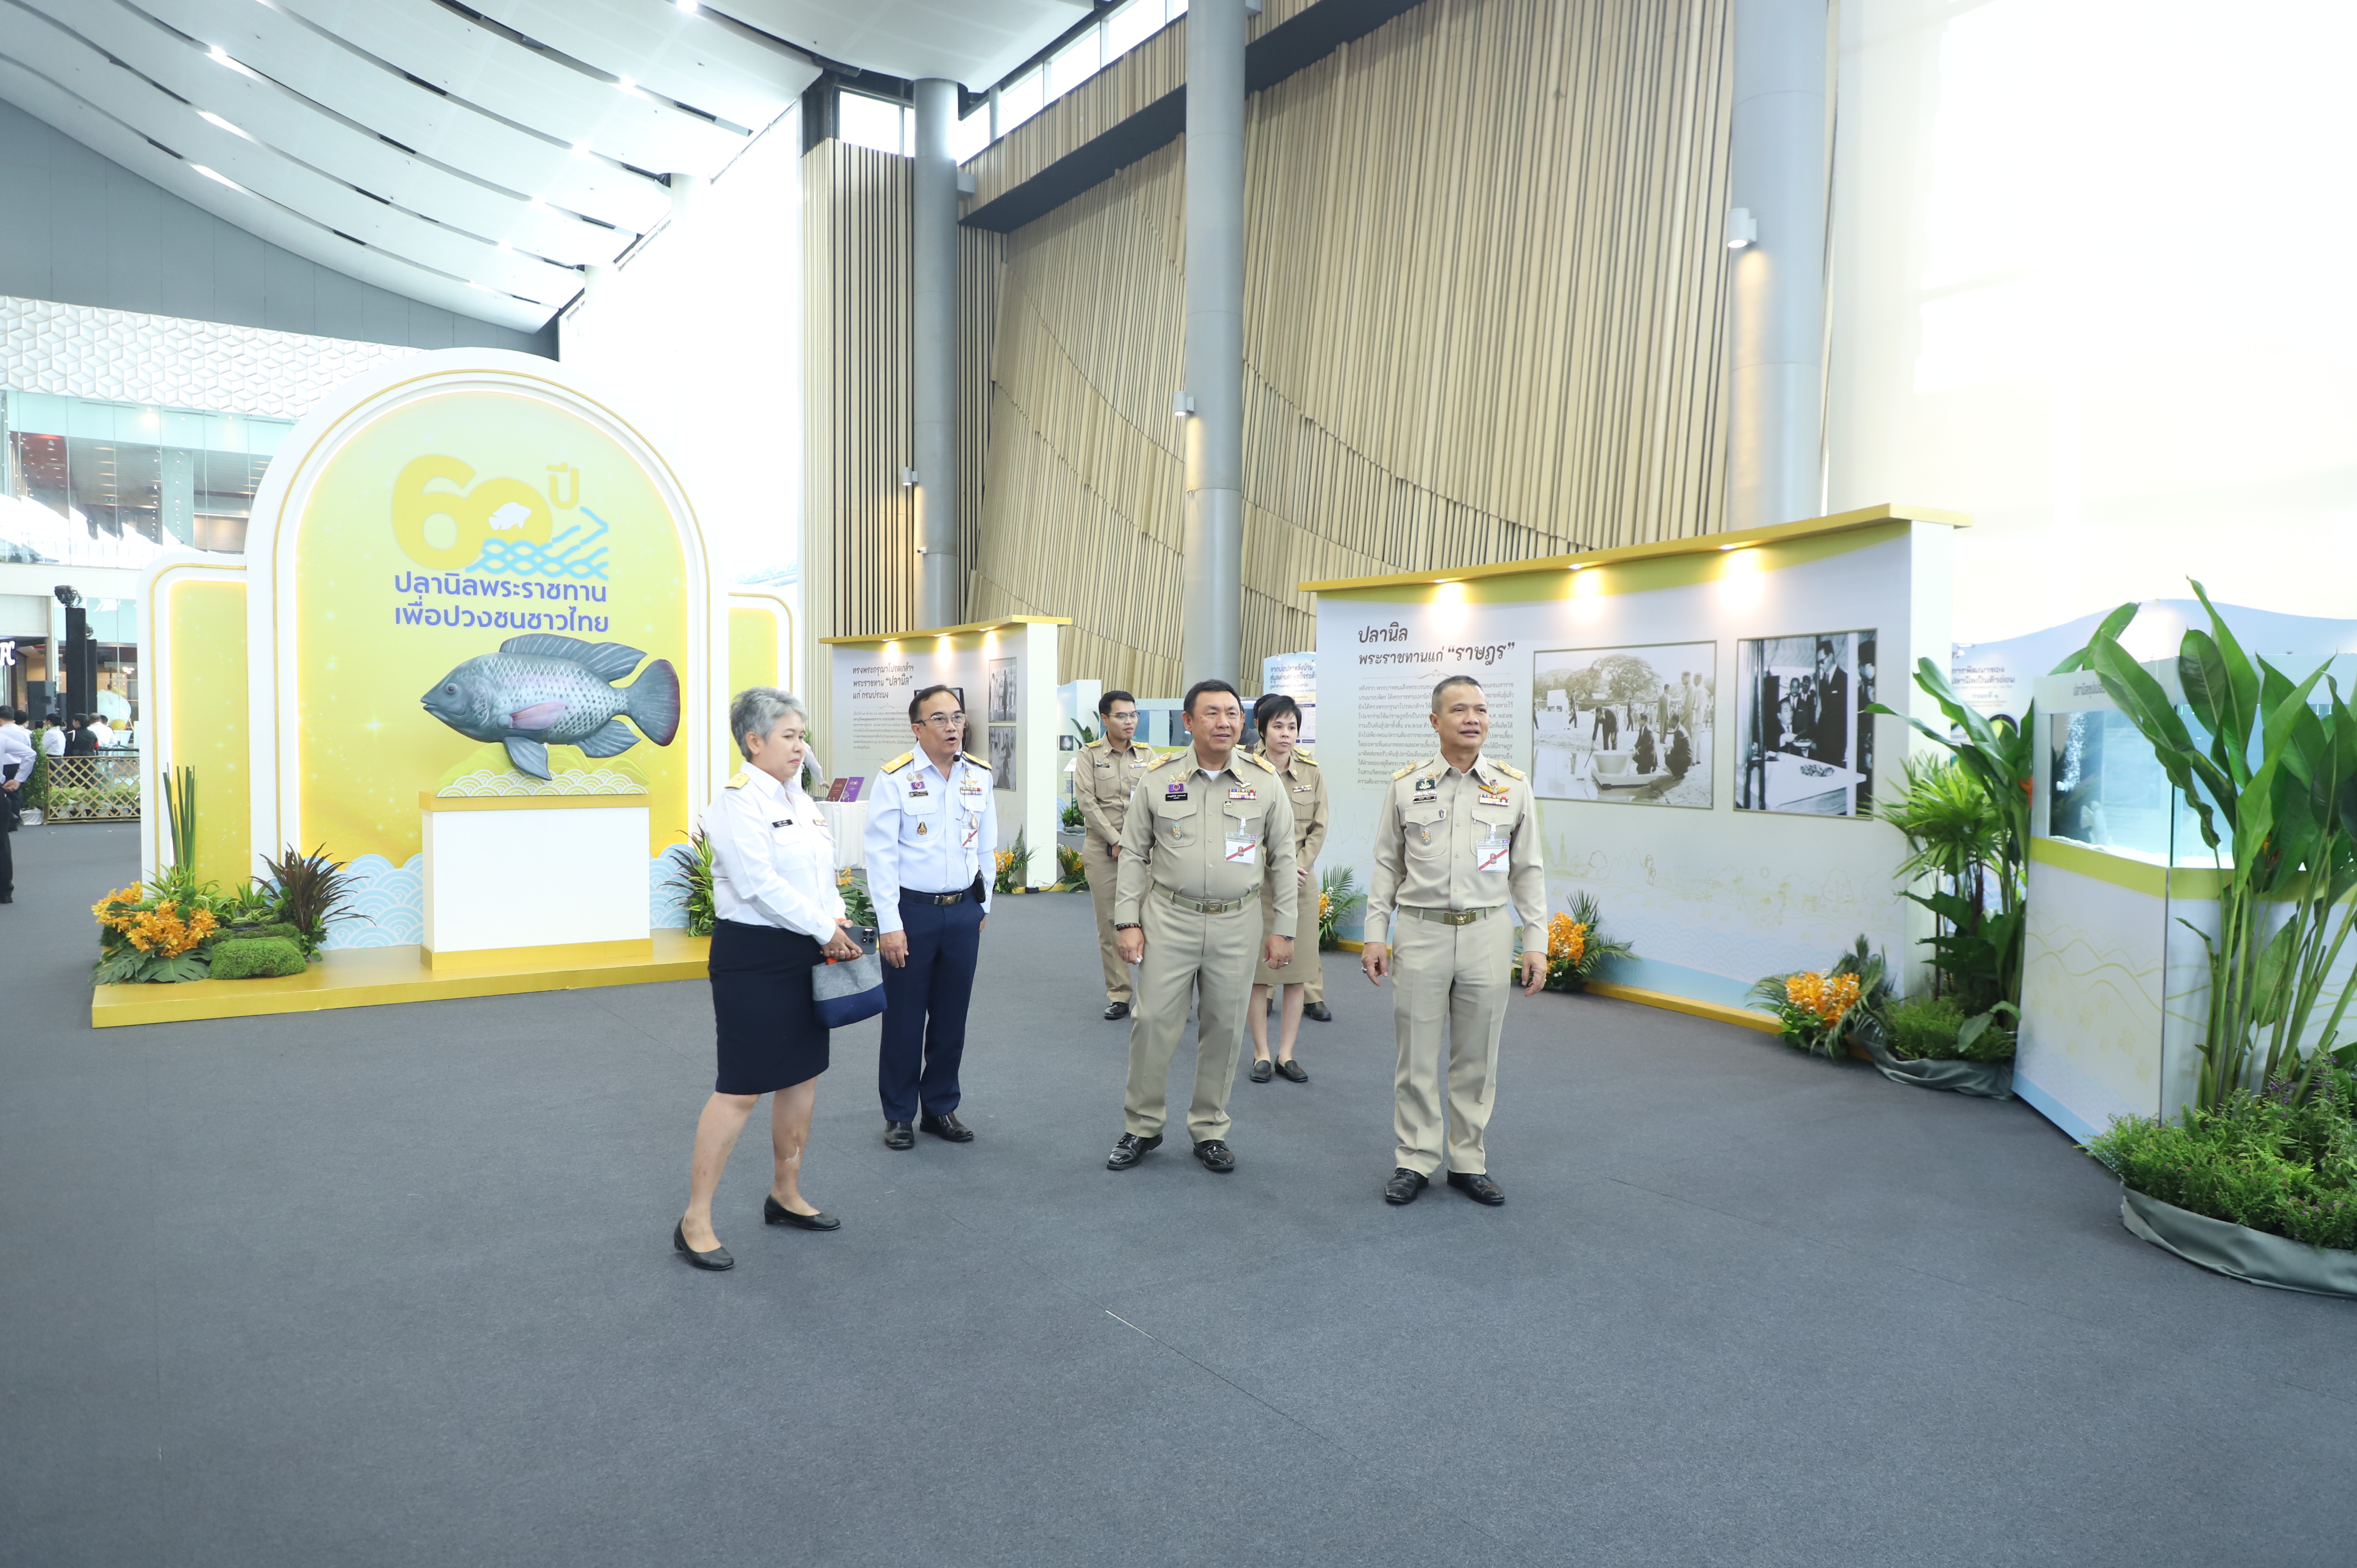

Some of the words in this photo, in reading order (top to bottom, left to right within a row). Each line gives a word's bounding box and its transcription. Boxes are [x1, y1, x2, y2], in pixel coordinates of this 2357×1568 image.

[546, 462, 578, 509] ปี
[394, 571, 607, 602] ปลานิลพระราชทาน
[395, 595, 610, 632] เพื่อปวงชนชาวไทย
[1358, 621, 1408, 643] ปลานิล
[0, 641, 16, 666] FC
[1359, 646, 1444, 664] พระราชทานแก่
[852, 662, 914, 676] ทรงพระกรุณาโปรดเกล้าฯ
[1270, 671, 1317, 684] สู่มูลค่าเศรษฐกิจระดั
[862, 691, 889, 699] กรมประมง
